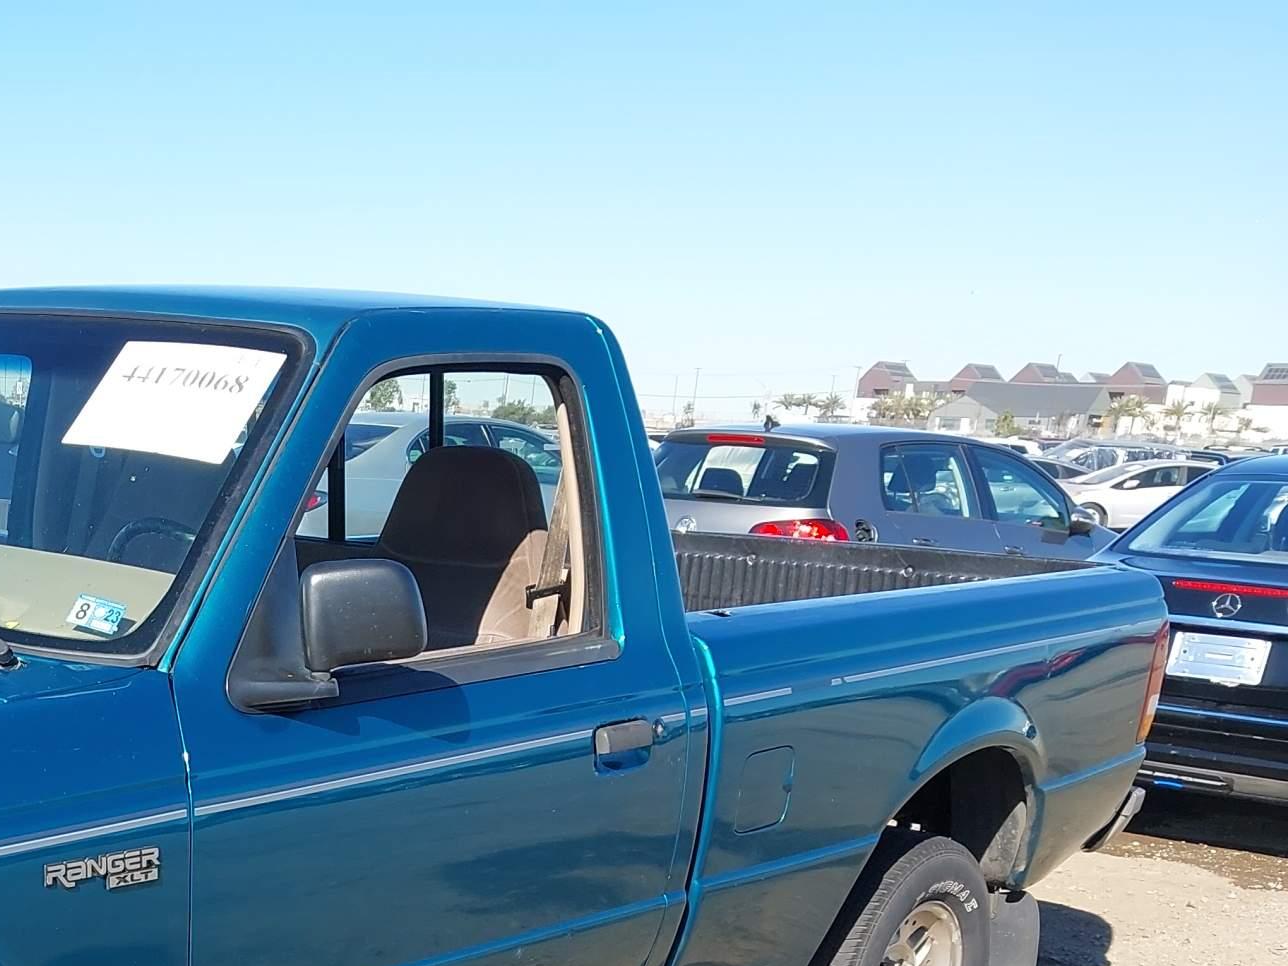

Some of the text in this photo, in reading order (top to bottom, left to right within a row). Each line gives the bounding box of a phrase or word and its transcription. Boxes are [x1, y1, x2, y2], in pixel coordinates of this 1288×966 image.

[122, 365, 249, 393] 44170068
[75, 602, 122, 624] 8 23
[44, 846, 161, 888] RANGER
[112, 868, 155, 887] XLT
